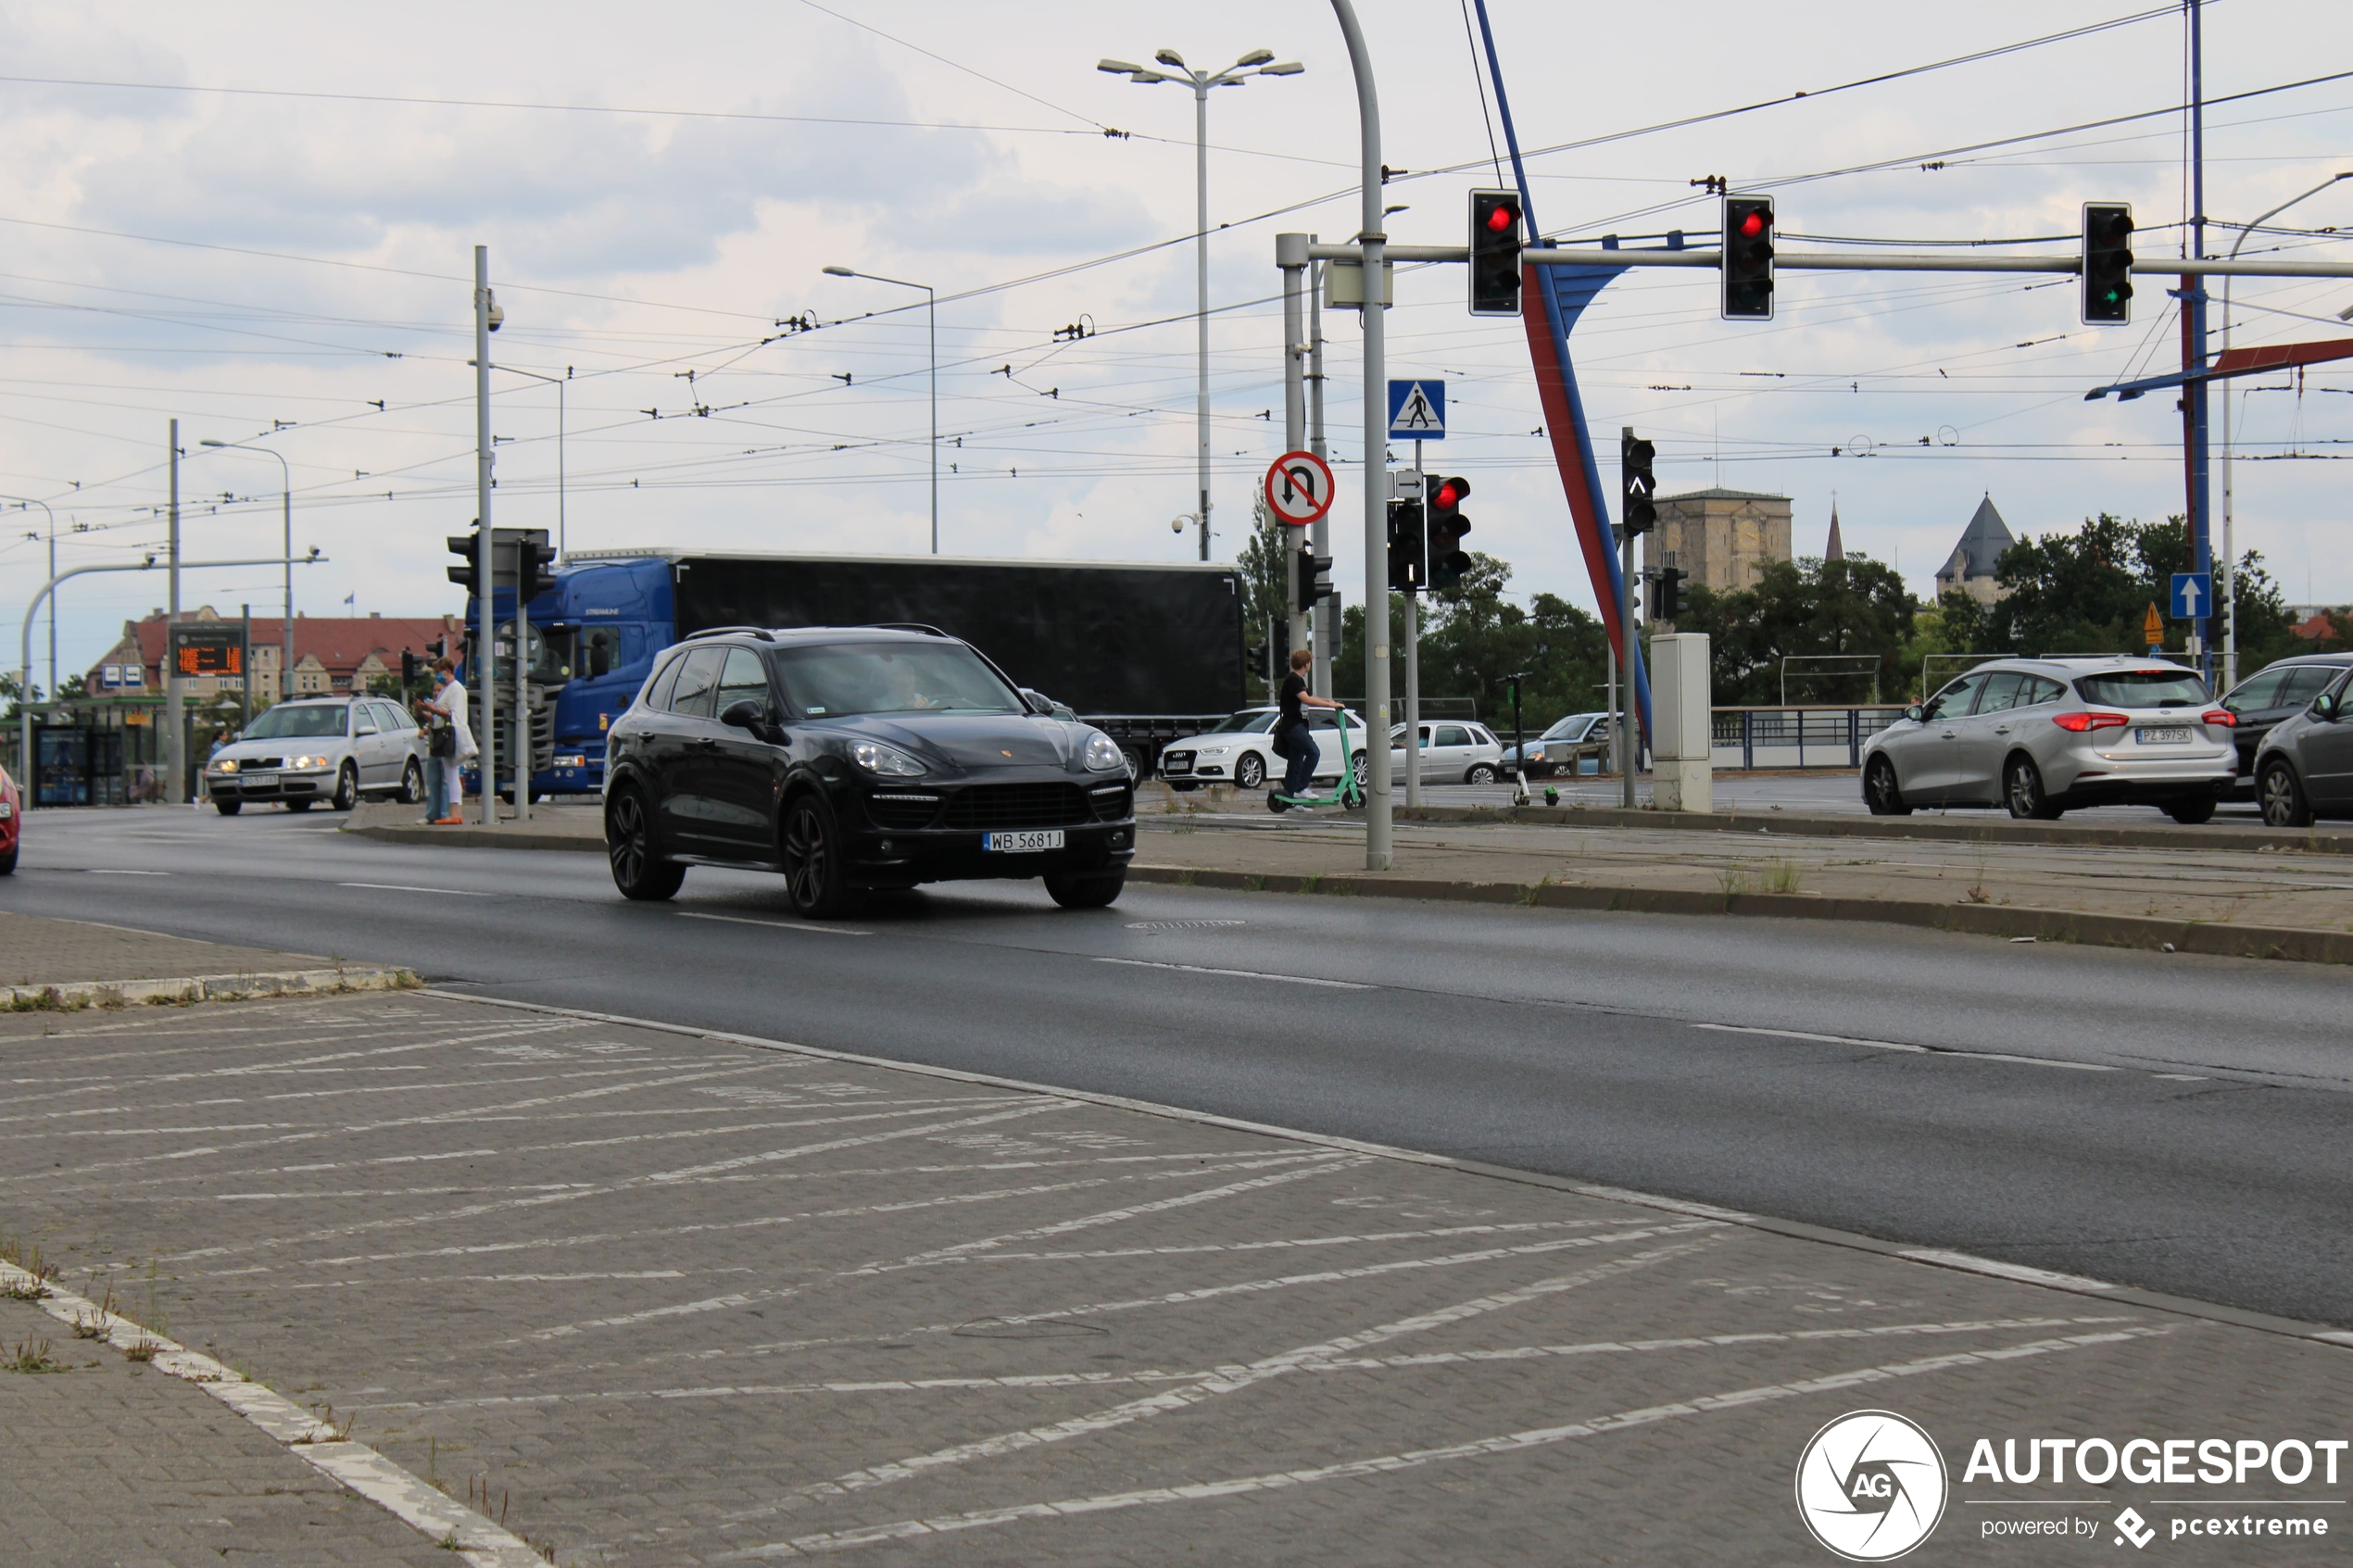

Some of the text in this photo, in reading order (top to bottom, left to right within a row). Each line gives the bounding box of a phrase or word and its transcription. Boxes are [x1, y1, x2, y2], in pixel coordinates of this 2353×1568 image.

[585, 608, 620, 616] STREAMLINE
[2144, 728, 2189, 741] PZ 397SK
[992, 832, 1061, 849] WB 5681J
